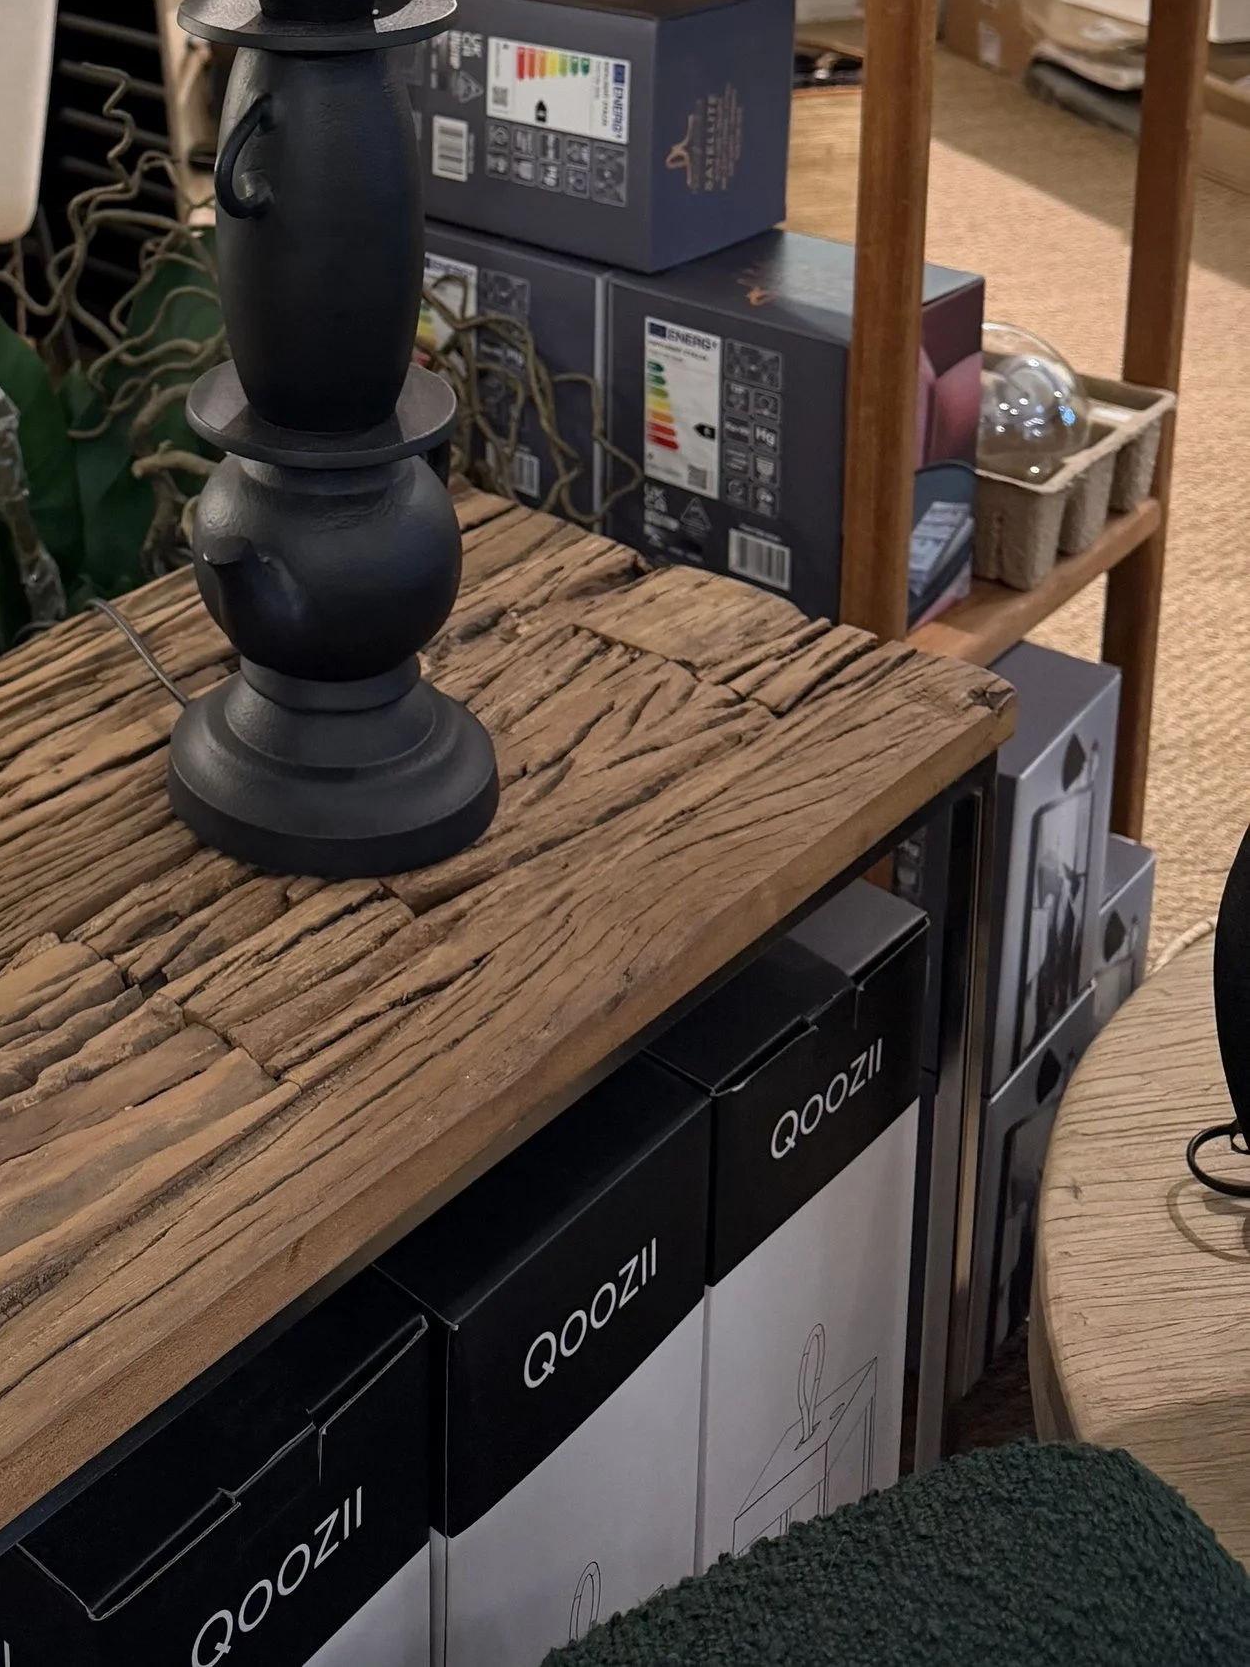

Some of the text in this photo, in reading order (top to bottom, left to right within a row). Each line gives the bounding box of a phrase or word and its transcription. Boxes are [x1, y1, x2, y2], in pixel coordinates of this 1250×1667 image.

[704, 94, 717, 192] SATELLITE
[769, 1037, 883, 1160] QOOZII
[522, 1237, 658, 1390] QOOZII
[191, 1485, 363, 1667] QOOZII
